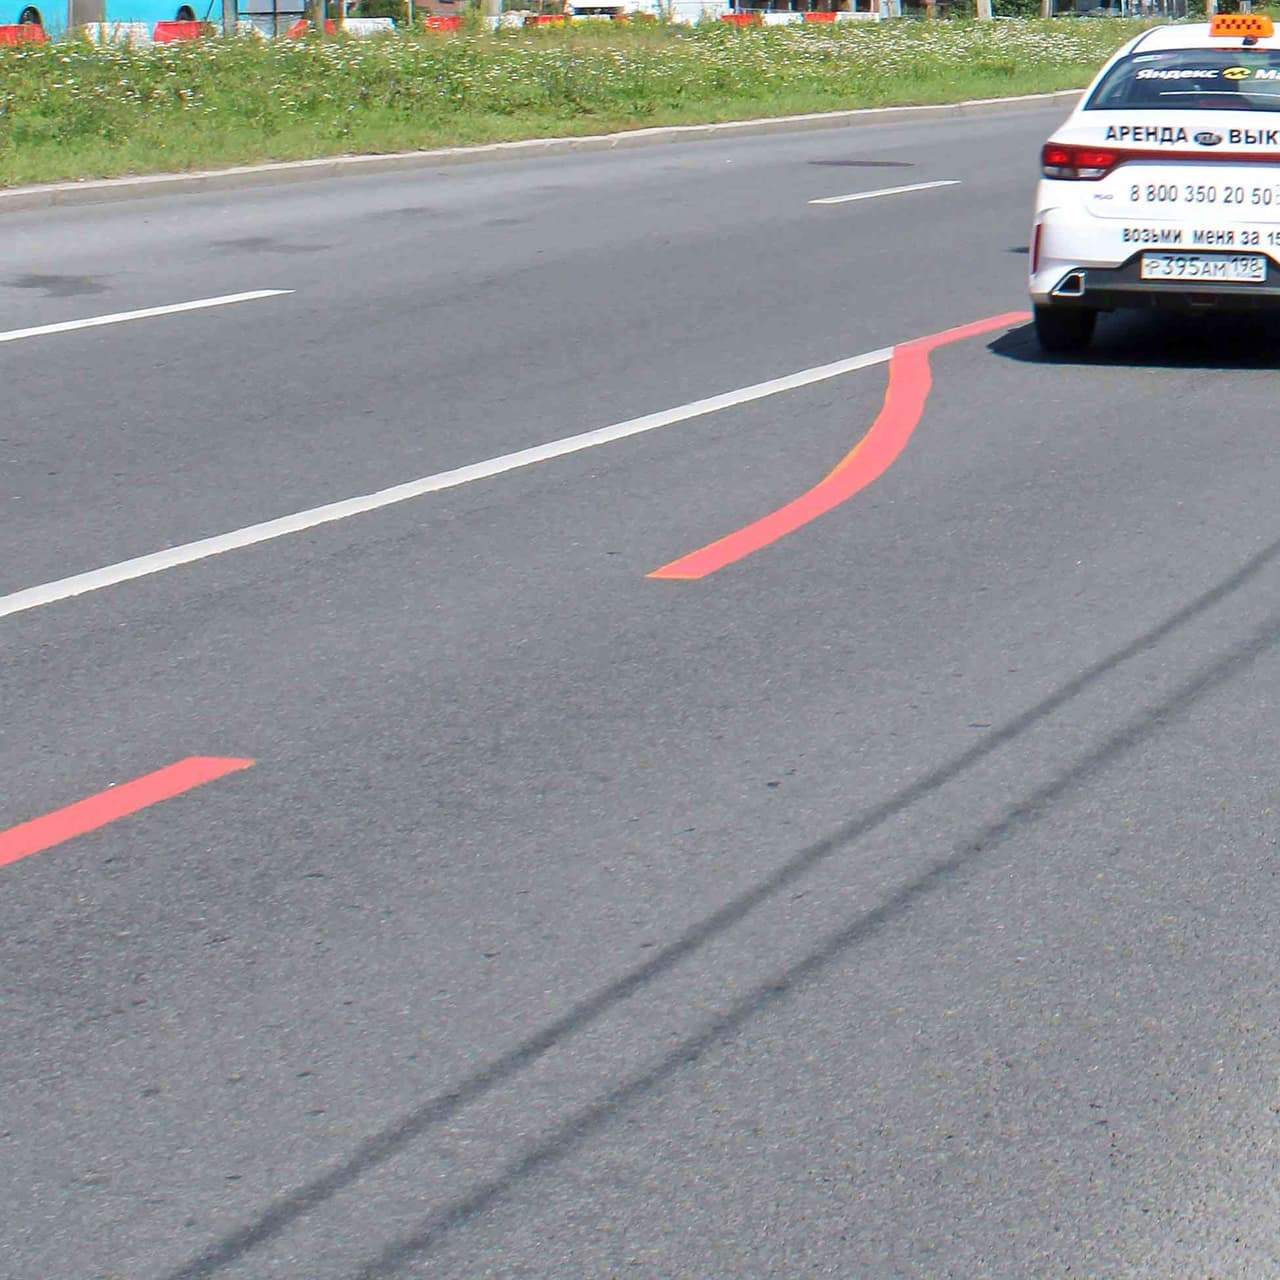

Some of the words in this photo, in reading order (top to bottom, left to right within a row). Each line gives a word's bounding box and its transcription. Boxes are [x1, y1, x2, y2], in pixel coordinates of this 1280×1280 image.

[1136, 69, 1219, 80] Яндекс
[1106, 125, 1187, 145] АРЕНДА
[1131, 185, 1140, 202] 8
[1147, 185, 1178, 202] 800
[1185, 186, 1216, 203] 350
[1223, 187, 1244, 204] 20
[1252, 188, 1272, 205] 50
[1123, 228, 1182, 243] возьми
[1193, 230, 1234, 245] меня
[1240, 231, 1260, 245] за
